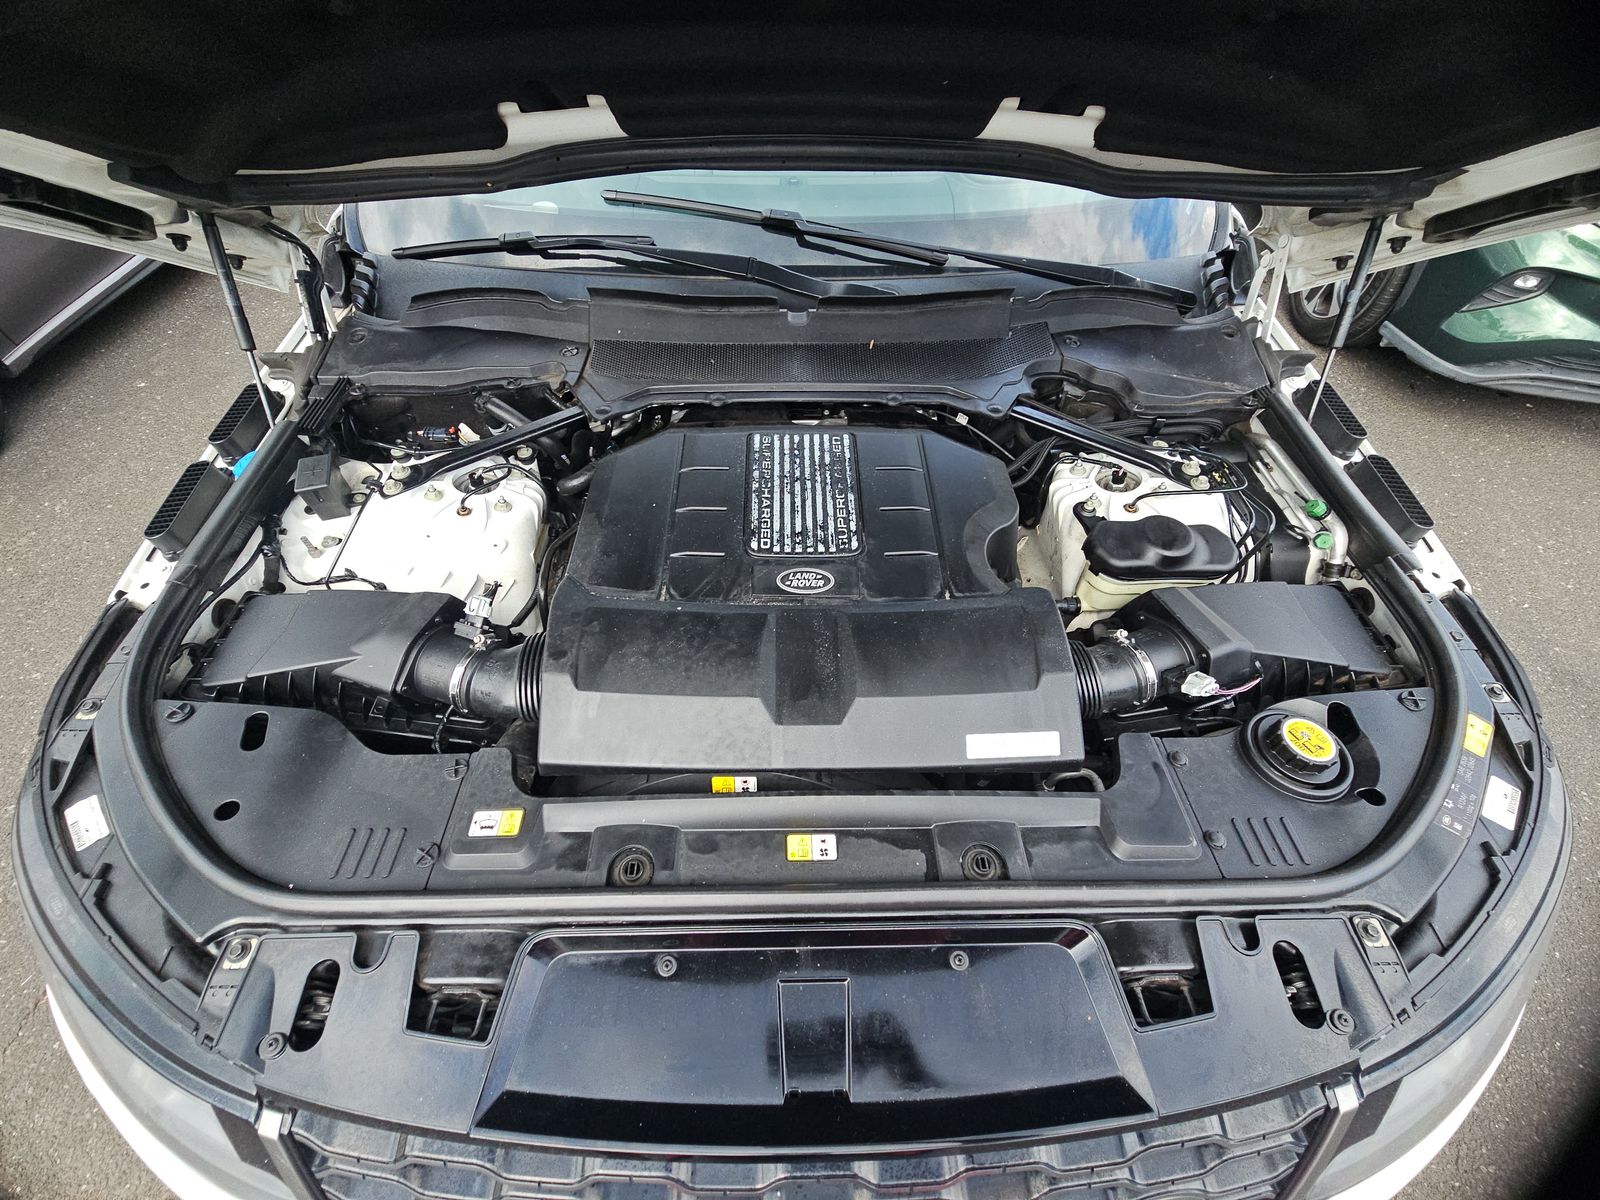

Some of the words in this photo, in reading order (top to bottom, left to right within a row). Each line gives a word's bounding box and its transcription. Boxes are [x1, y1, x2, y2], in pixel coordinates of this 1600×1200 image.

[760, 435, 771, 549] SUPERCHARGED
[789, 572, 816, 580] LAND
[790, 579, 825, 587] ROVER
